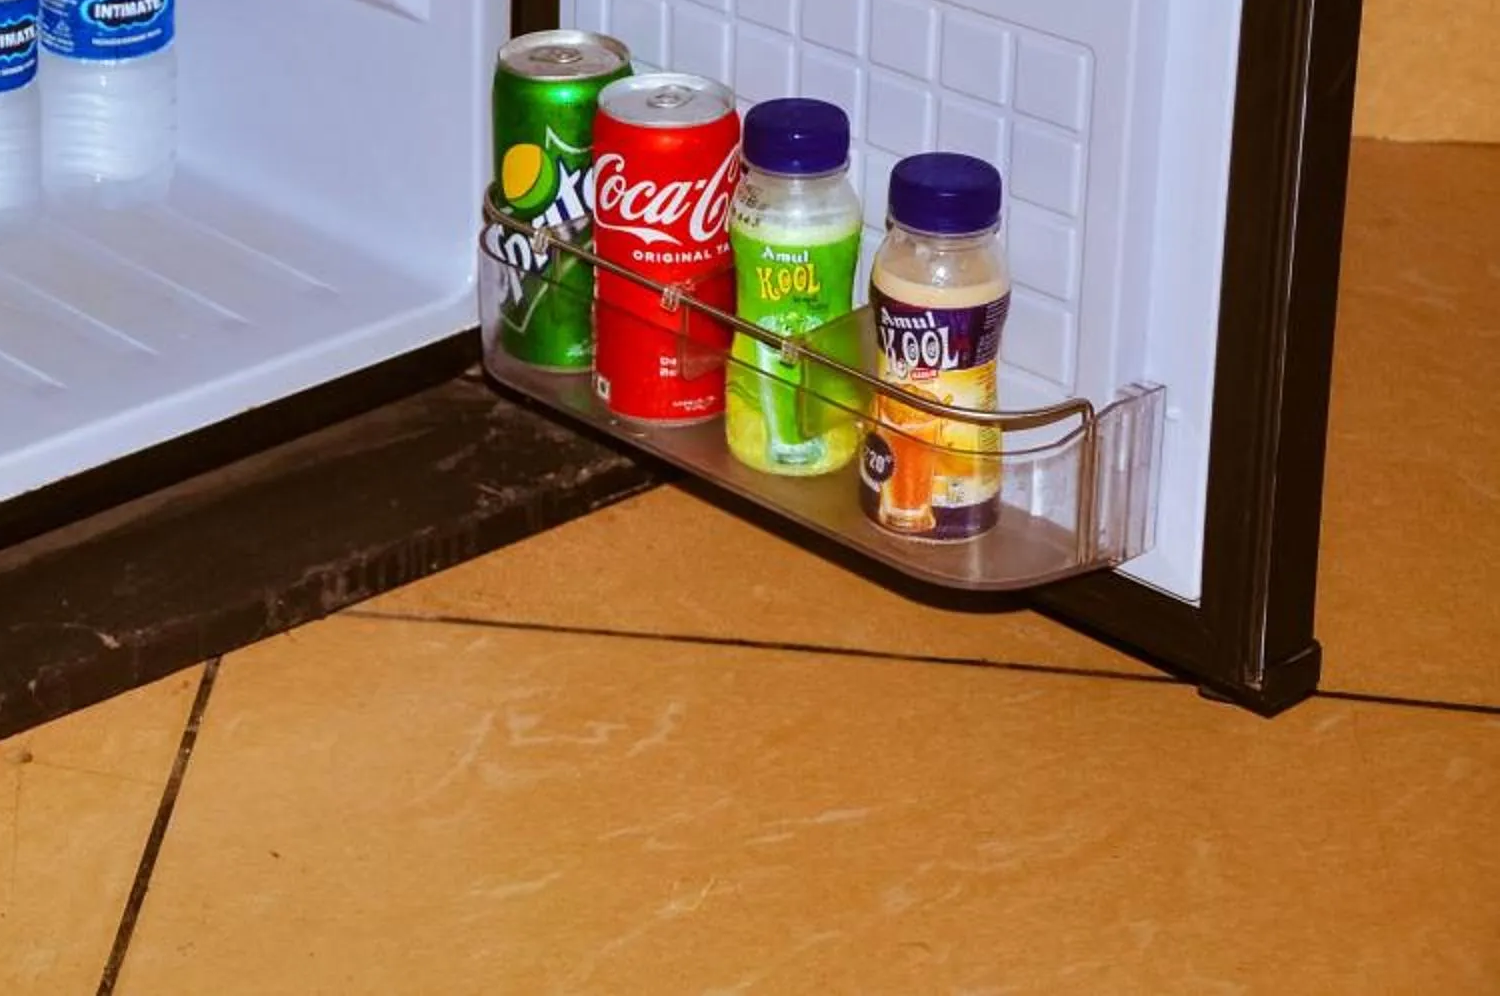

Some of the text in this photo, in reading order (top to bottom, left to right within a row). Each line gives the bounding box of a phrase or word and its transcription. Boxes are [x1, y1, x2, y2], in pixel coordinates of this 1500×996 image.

[631, 248, 713, 264] ORIGINAL
[761, 245, 809, 264] Amul
[755, 263, 821, 302] KOOL
[880, 306, 936, 329] Amul
[880, 325, 959, 379] KOOL
